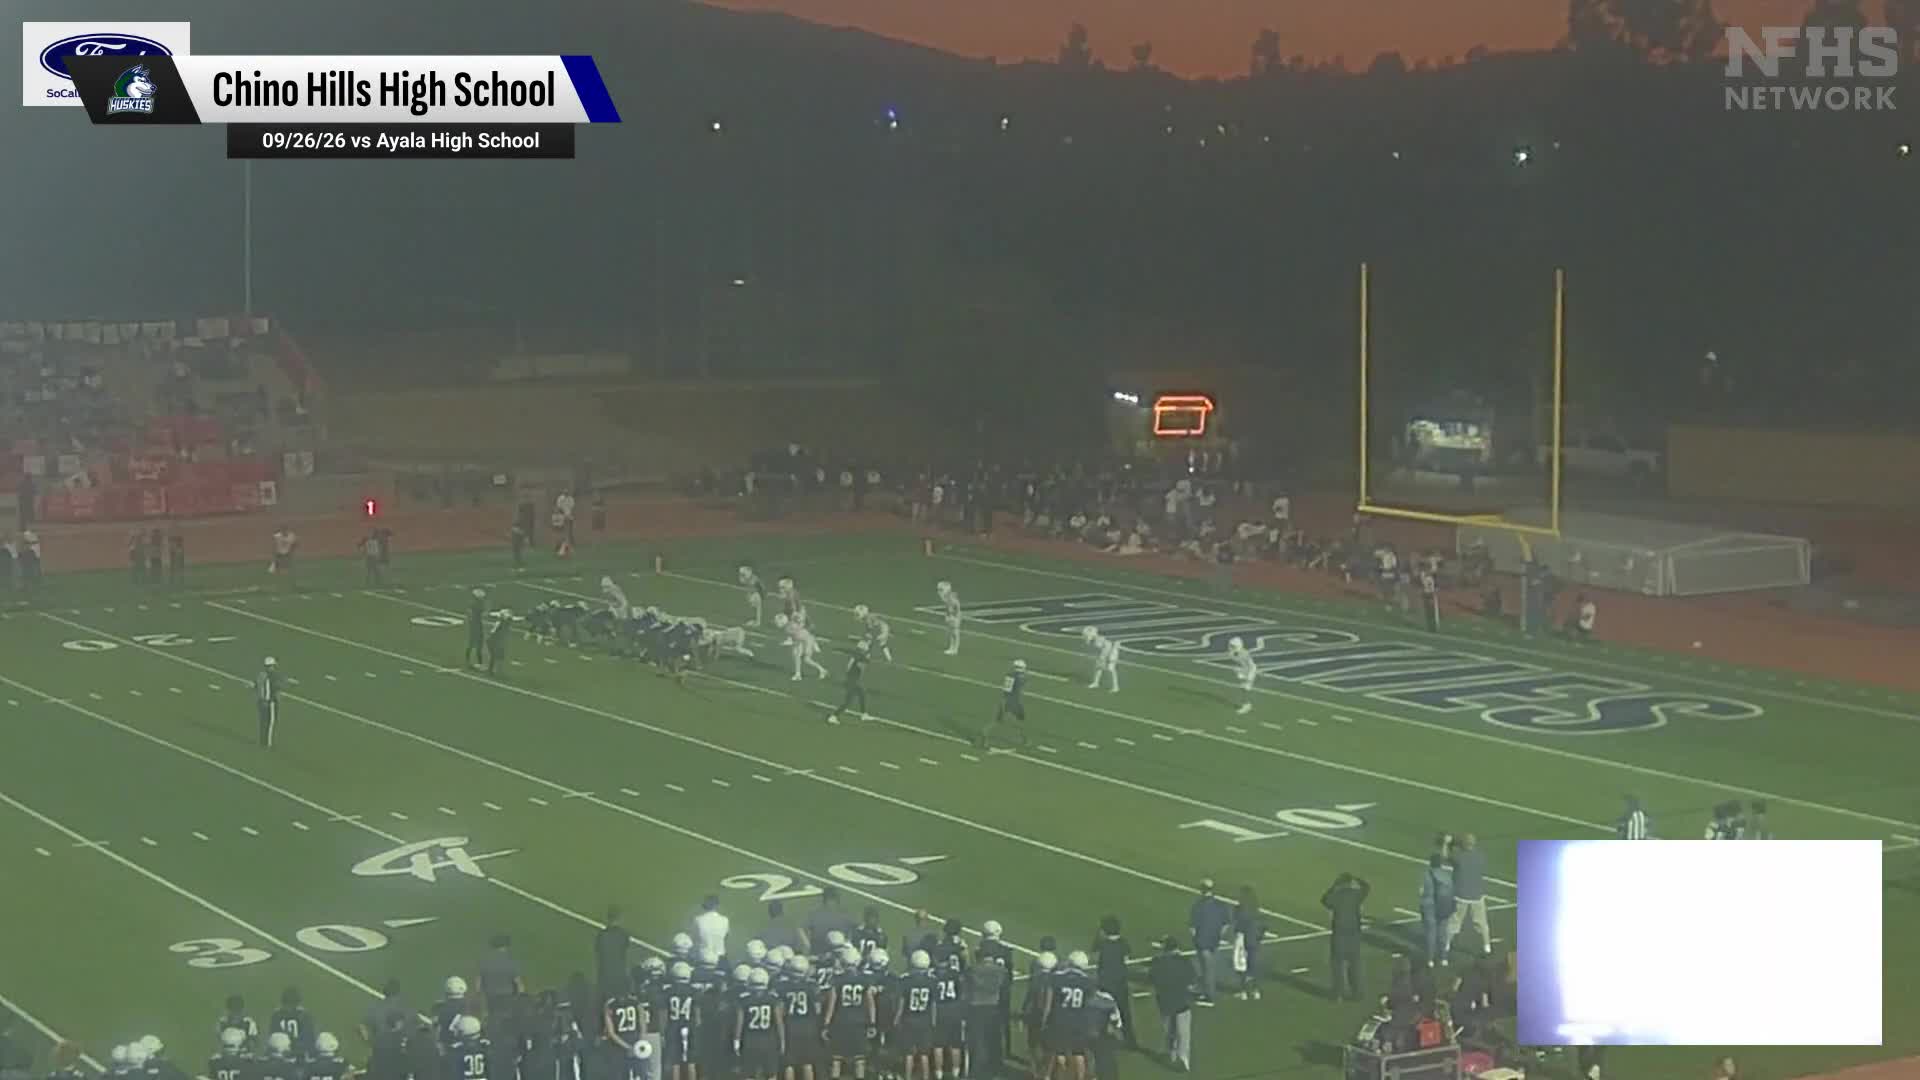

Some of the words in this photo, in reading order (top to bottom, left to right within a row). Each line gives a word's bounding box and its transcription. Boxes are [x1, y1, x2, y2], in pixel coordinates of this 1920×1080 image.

[366, 500, 374, 515] 1
[914, 593, 1765, 735] HUSKIES
[1178, 808, 1364, 842] 10
[720, 862, 918, 901] 20
[168, 924, 388, 968] 30
[670, 996, 693, 1021] 94
[786, 991, 808, 1015] 79
[909, 987, 930, 1012] 69
[1061, 987, 1084, 1008] 78
[615, 1005, 637, 1032] 29
[748, 1004, 771, 1029] 28
[463, 1053, 485, 1076] 36
